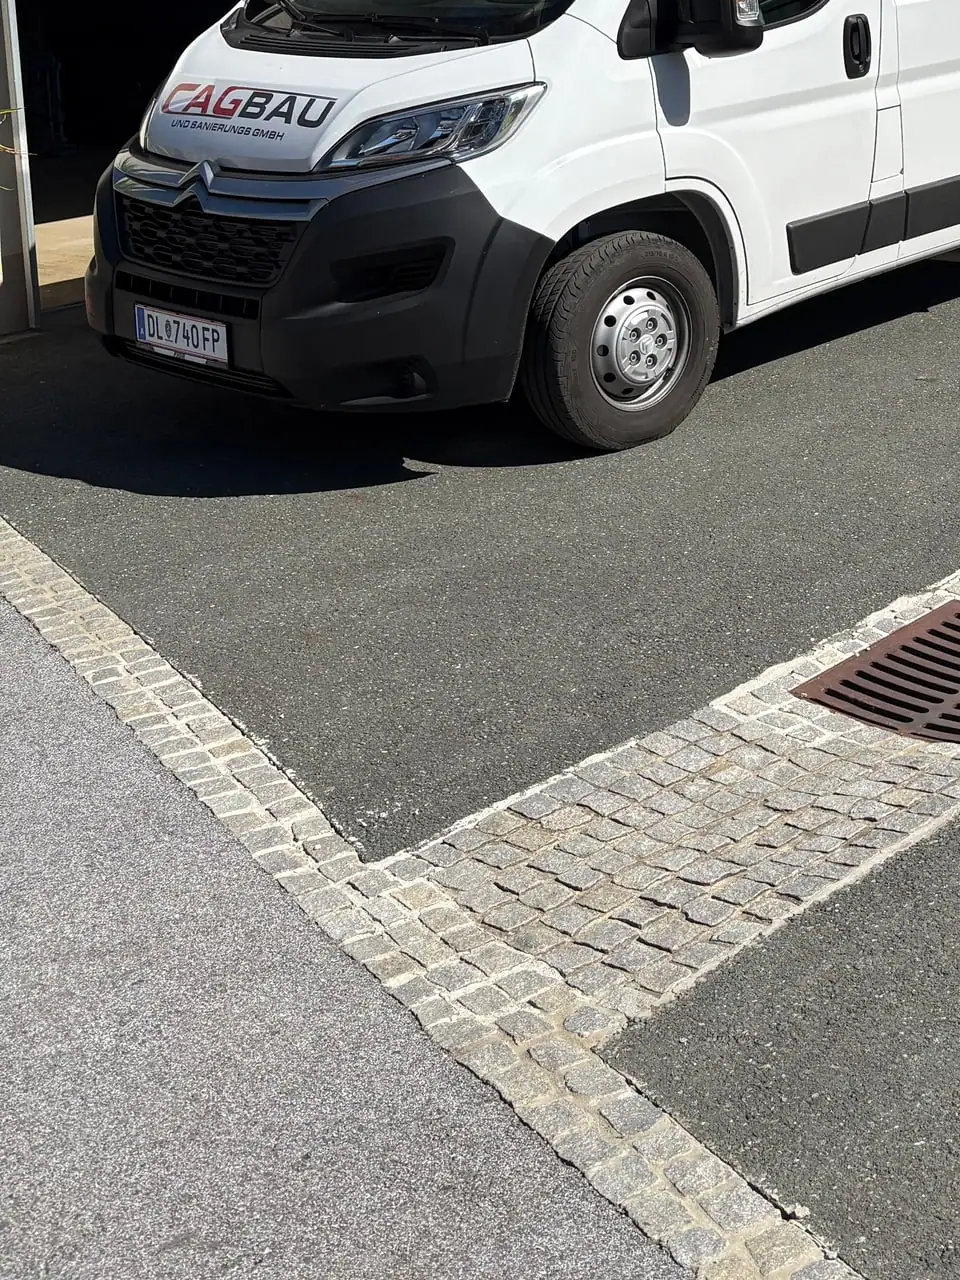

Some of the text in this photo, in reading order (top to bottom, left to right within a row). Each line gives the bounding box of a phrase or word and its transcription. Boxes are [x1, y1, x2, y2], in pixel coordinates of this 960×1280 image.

[161, 84, 338, 128] CAGBAU
[171, 119, 285, 141] UND SANIERUNGS GMBH
[147, 313, 163, 341] DL
